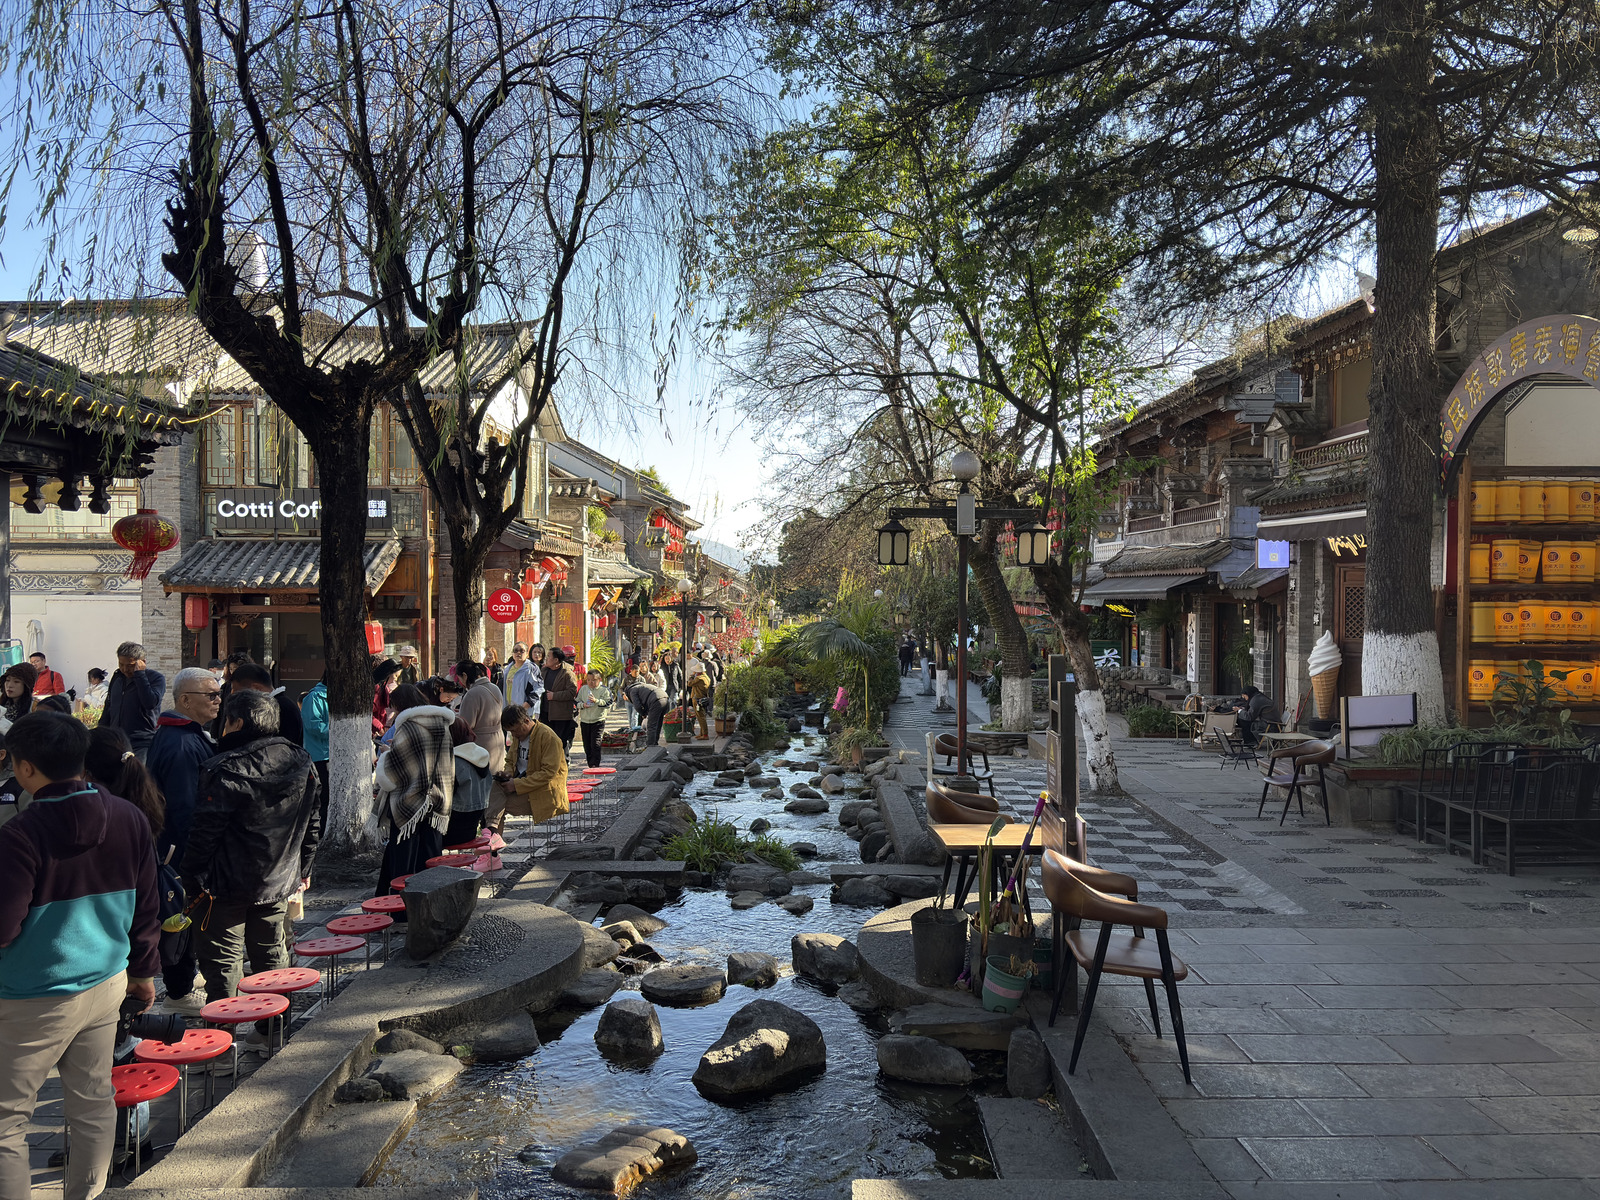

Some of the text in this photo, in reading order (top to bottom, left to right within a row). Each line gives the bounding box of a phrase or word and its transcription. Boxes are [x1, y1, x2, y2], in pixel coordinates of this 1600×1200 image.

[217, 499, 322, 518] Cotti Cof
[492, 604, 518, 612] COTTI
